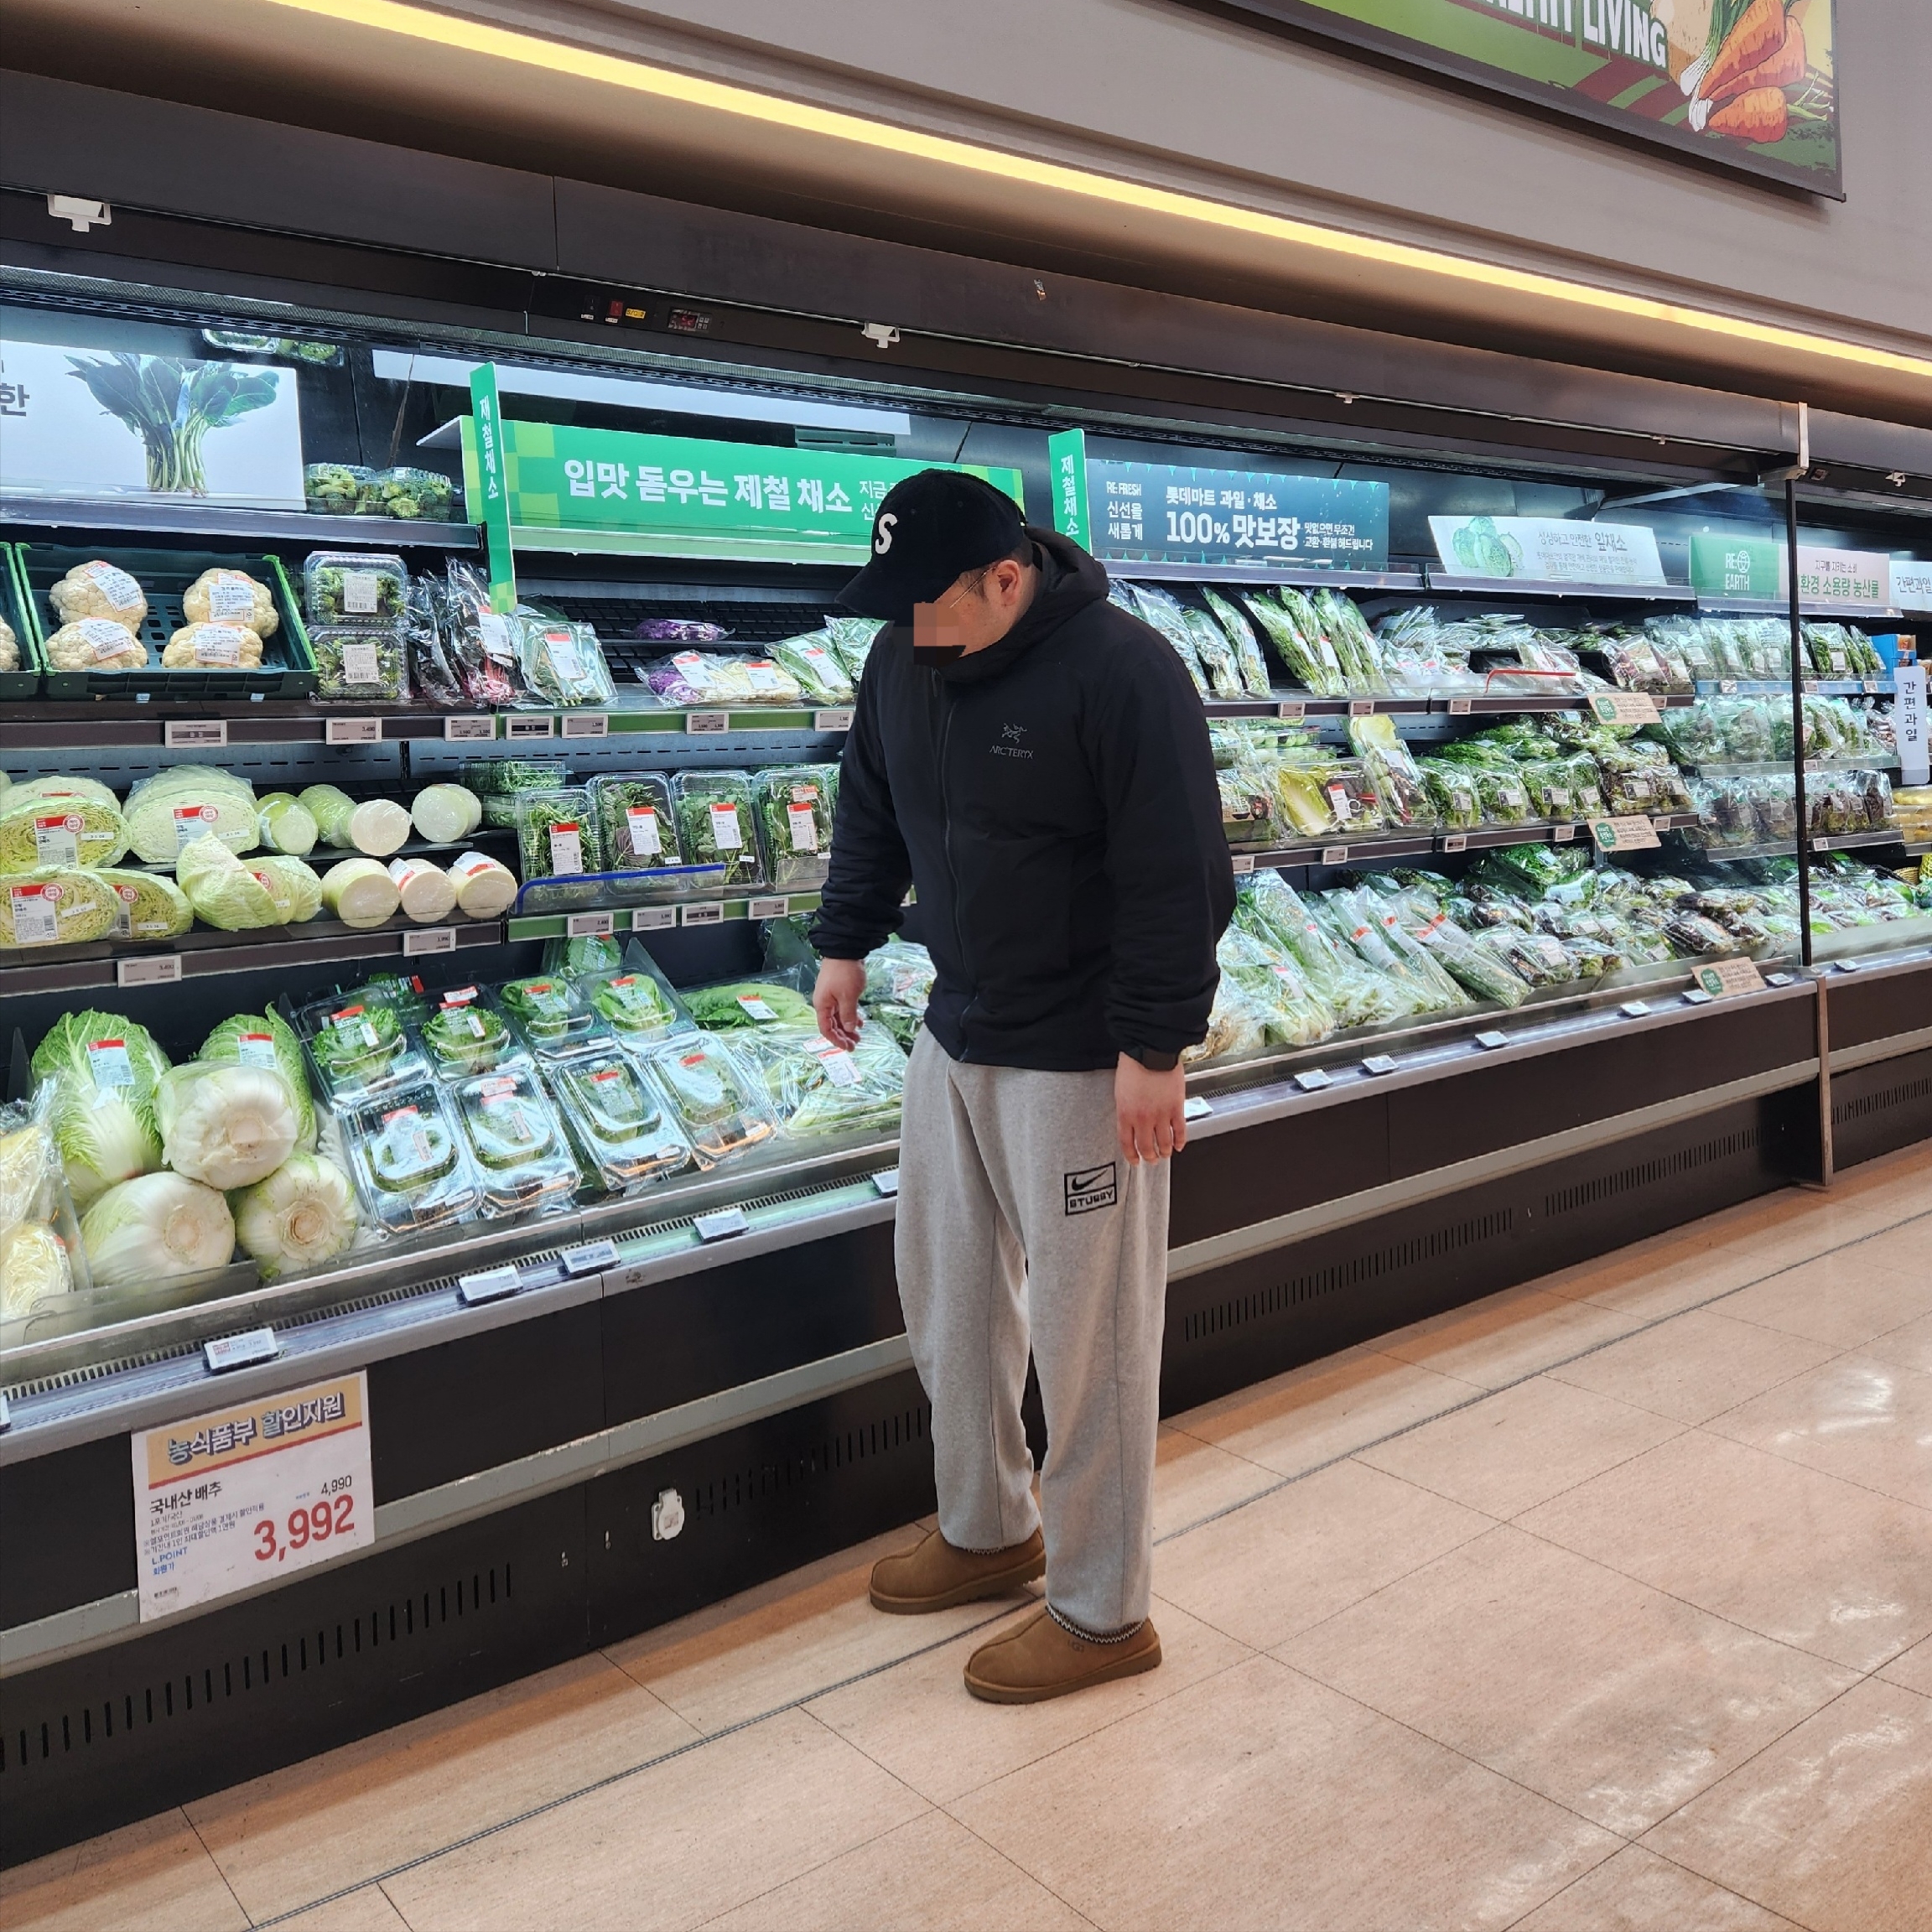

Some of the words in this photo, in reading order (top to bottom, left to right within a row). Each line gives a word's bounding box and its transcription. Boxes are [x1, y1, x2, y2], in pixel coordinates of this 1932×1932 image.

[1583, 0, 1666, 68] LIVING
[564, 460, 630, 500] 입맛
[636, 465, 729, 506] 돋우는
[734, 474, 791, 512] 제철
[797, 478, 853, 514] 채소
[860, 480, 887, 499] 지금
[1061, 454, 1079, 536] 제철채소
[1166, 486, 1216, 506] 롯데마트
[1107, 501, 1143, 520] 신선을
[873, 512, 898, 554] S
[1108, 522, 1143, 541] 새롭게
[1166, 511, 1230, 543] 100%
[1233, 514, 1301, 551] 맛보장
[1304, 522, 1333, 535] 맛없으면
[1334, 524, 1355, 536] 무조건
[1570, 532, 1592, 548] 안전한
[1595, 532, 1628, 553] 잎채소
[1725, 574, 1750, 591] EARTH
[1798, 574, 1820, 595] 환경
[1823, 576, 1851, 596] 소용량
[1853, 579, 1879, 598] 농산물
[1896, 576, 1932, 594] 간편과일
[1903, 681, 1918, 742] 간편과일
[168, 1415, 257, 1465] 농식품부
[262, 1391, 345, 1438] 할인지원
[150, 1488, 193, 1514] 국내산
[195, 1481, 222, 1501] 배추
[321, 1475, 352, 1497] 4,990
[254, 1493, 355, 1561] 3,992
[152, 1546, 188, 1566] L.POINT
